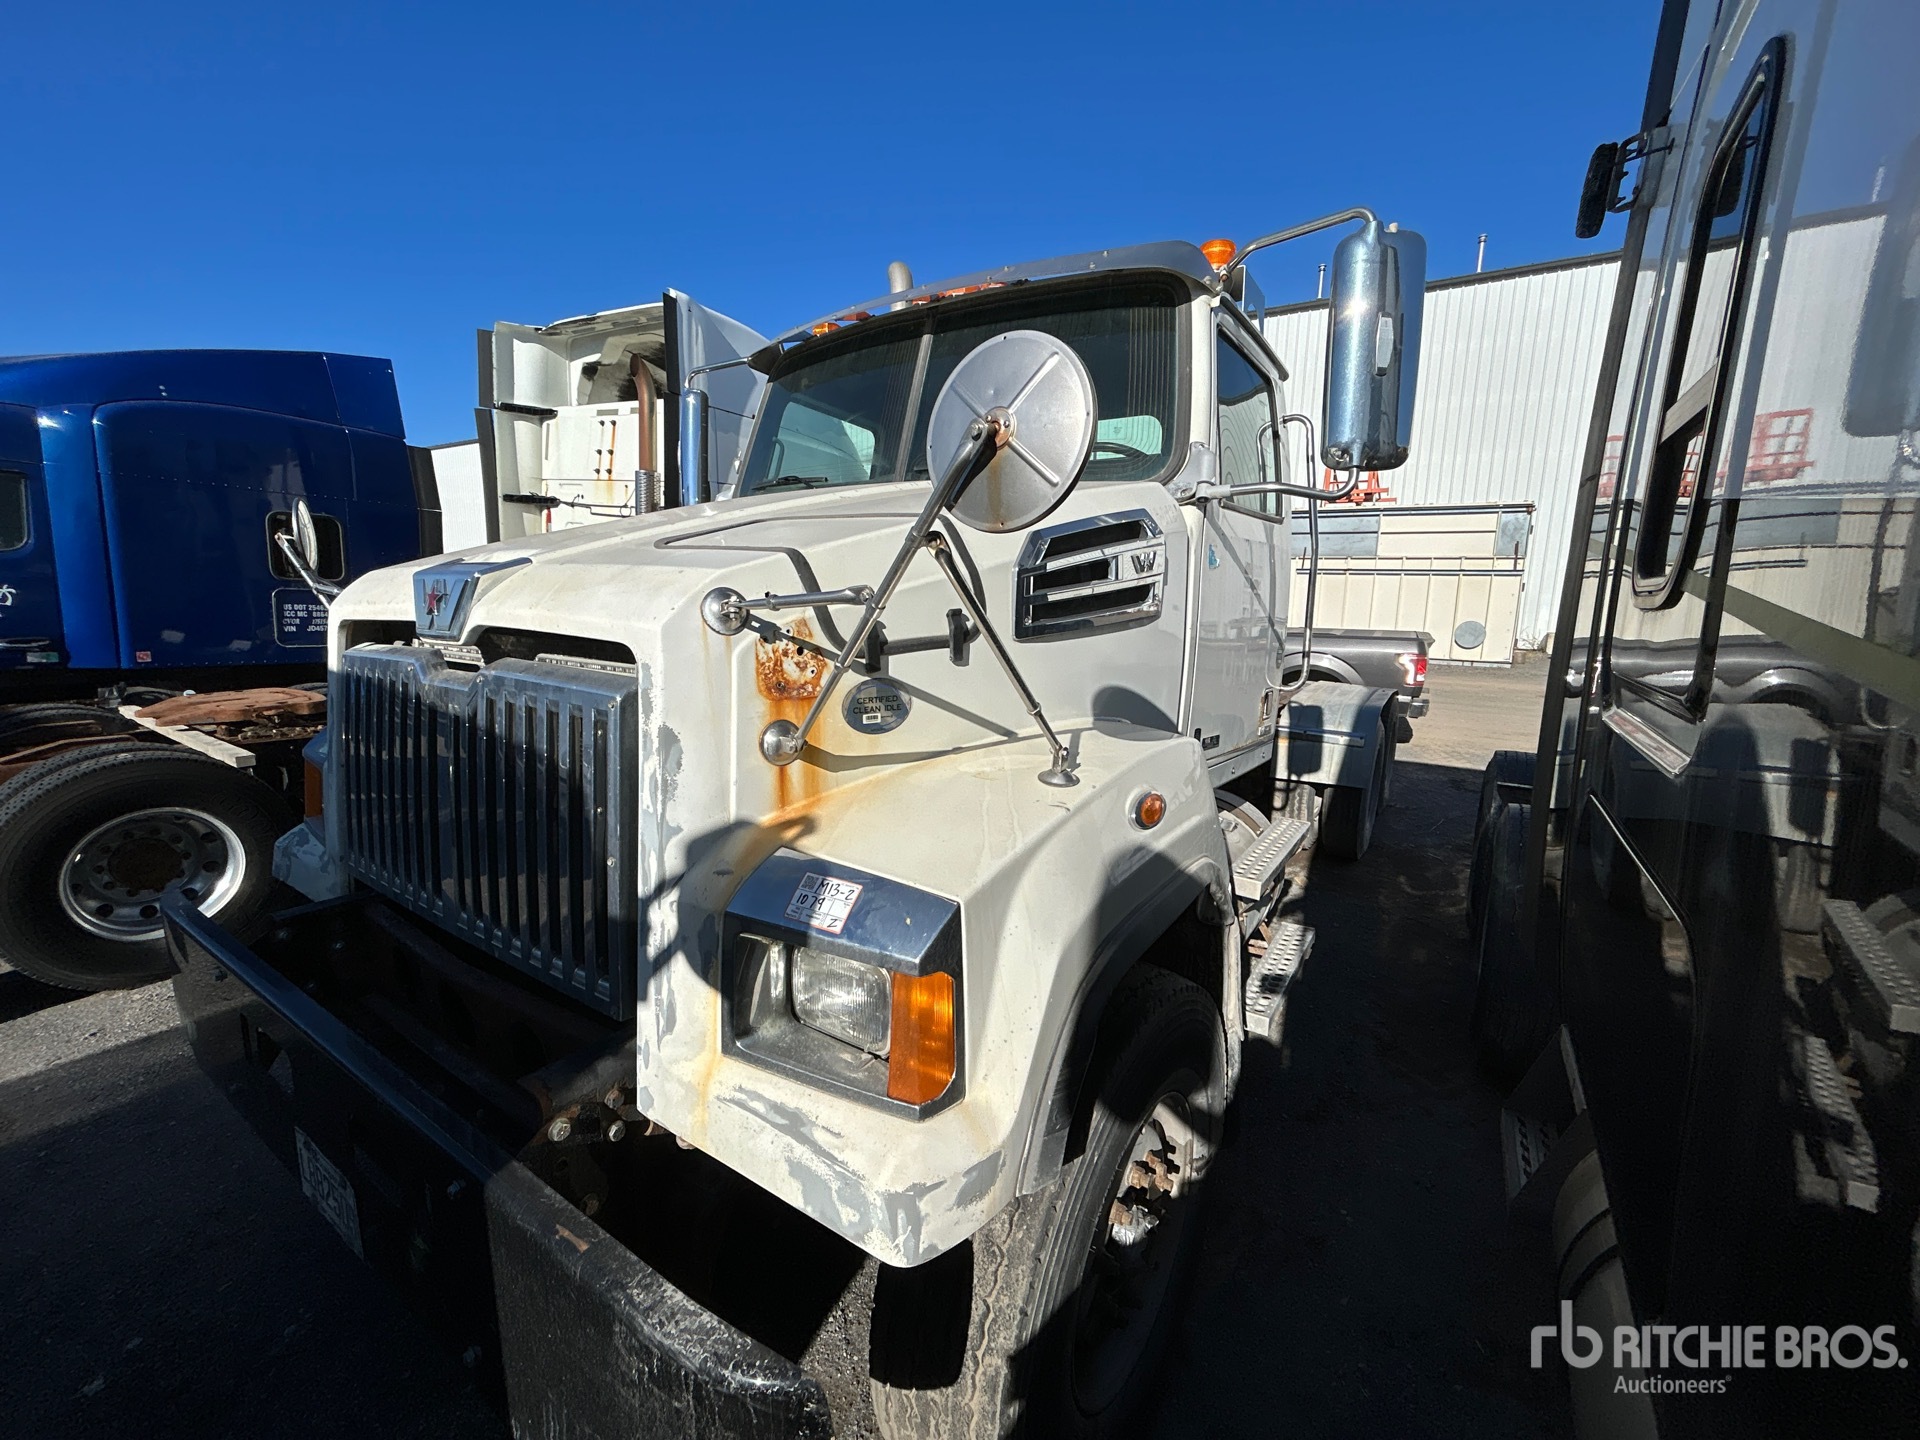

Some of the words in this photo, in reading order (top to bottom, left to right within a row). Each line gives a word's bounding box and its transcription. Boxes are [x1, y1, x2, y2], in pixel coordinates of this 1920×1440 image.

[856, 695, 898, 705] CERTIFIED
[852, 705, 881, 715] CLEAN
[884, 704, 902, 712] IDLE
[814, 879, 855, 901] M13-2
